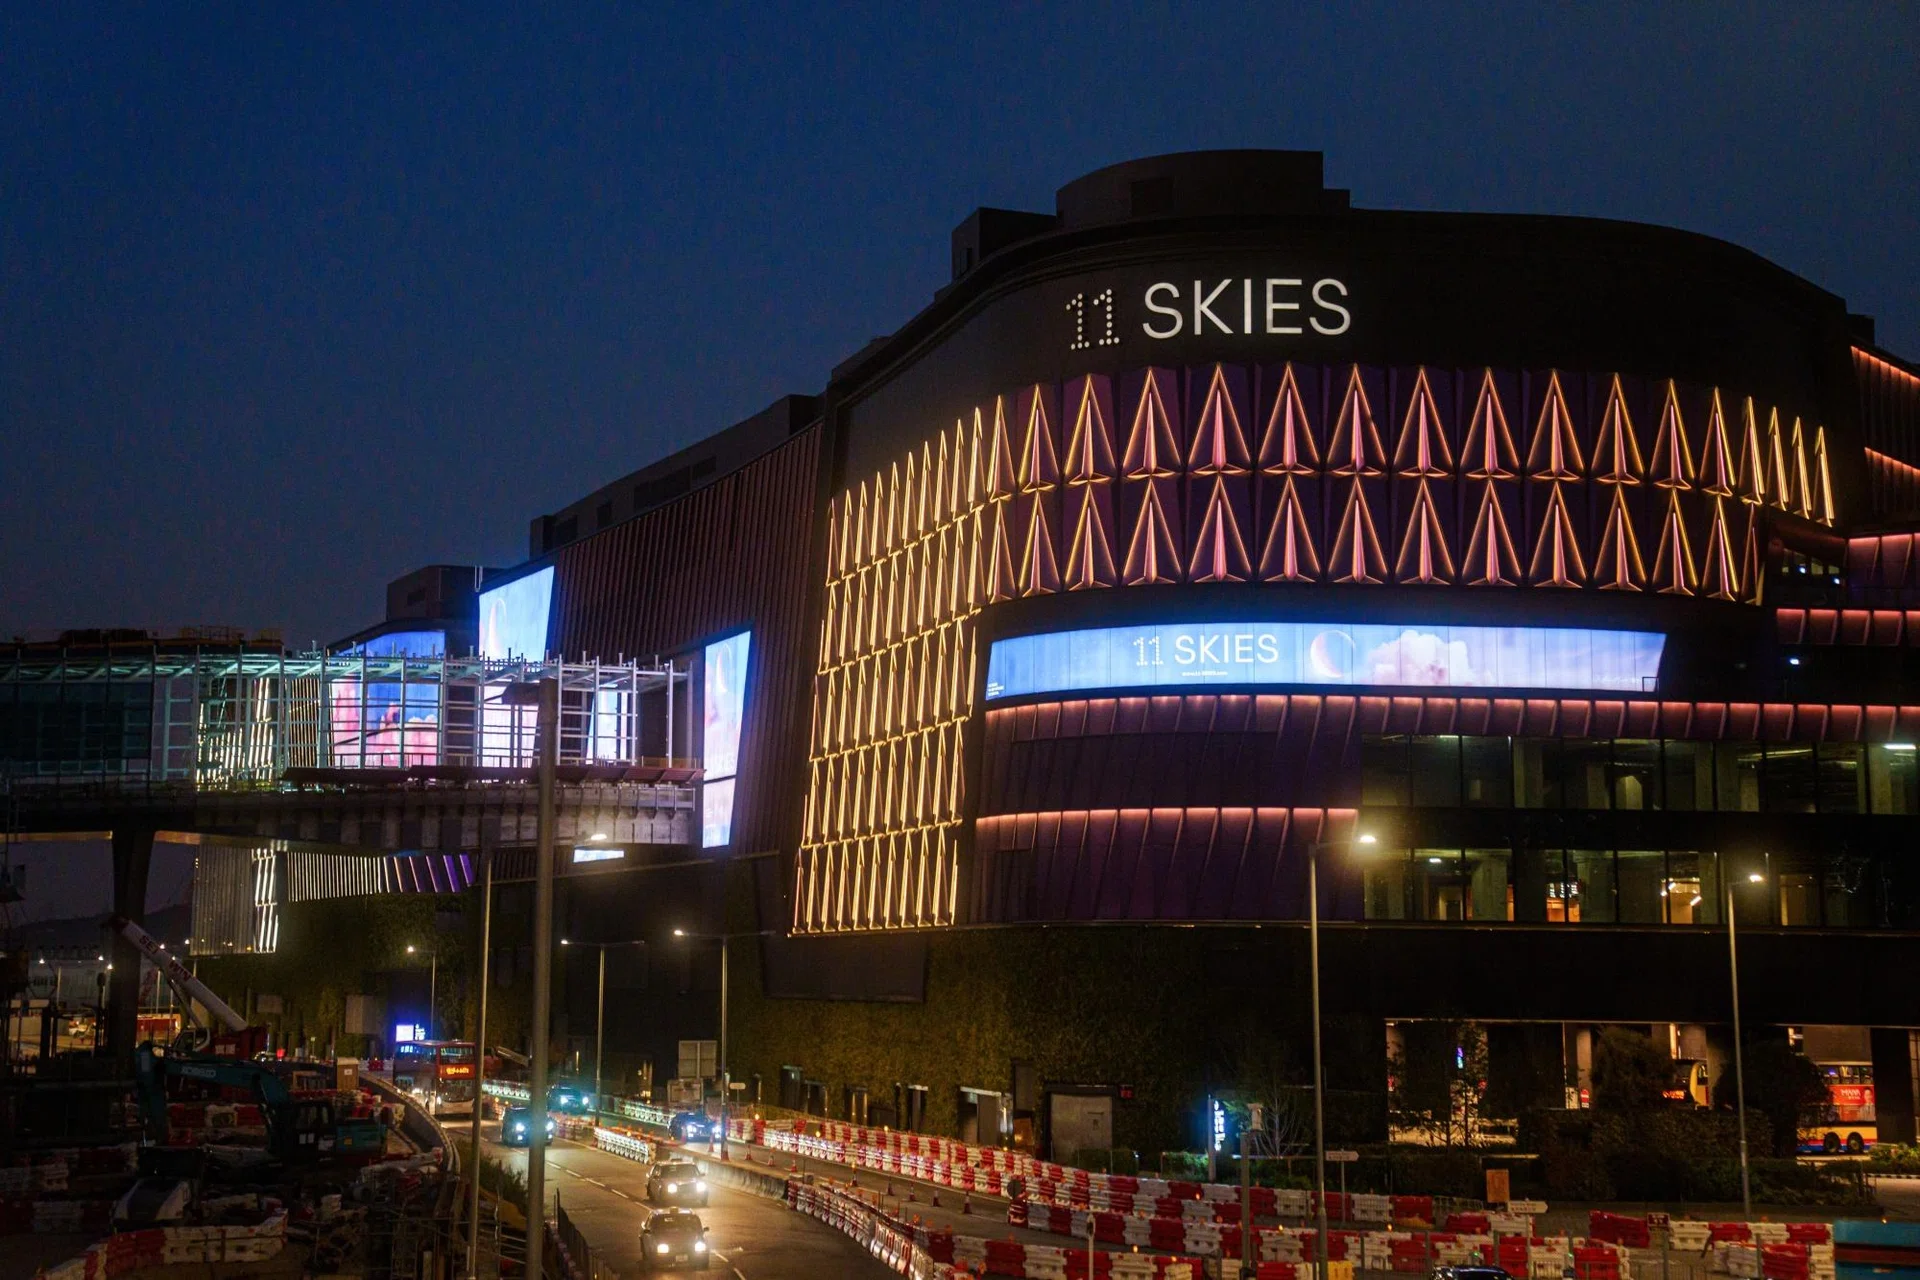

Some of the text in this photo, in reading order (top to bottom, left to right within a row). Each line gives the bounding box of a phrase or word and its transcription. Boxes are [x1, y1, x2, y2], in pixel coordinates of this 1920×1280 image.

[1065, 278, 1351, 350] 11 SKIES
[1133, 634, 1279, 666] 11 SKIES
